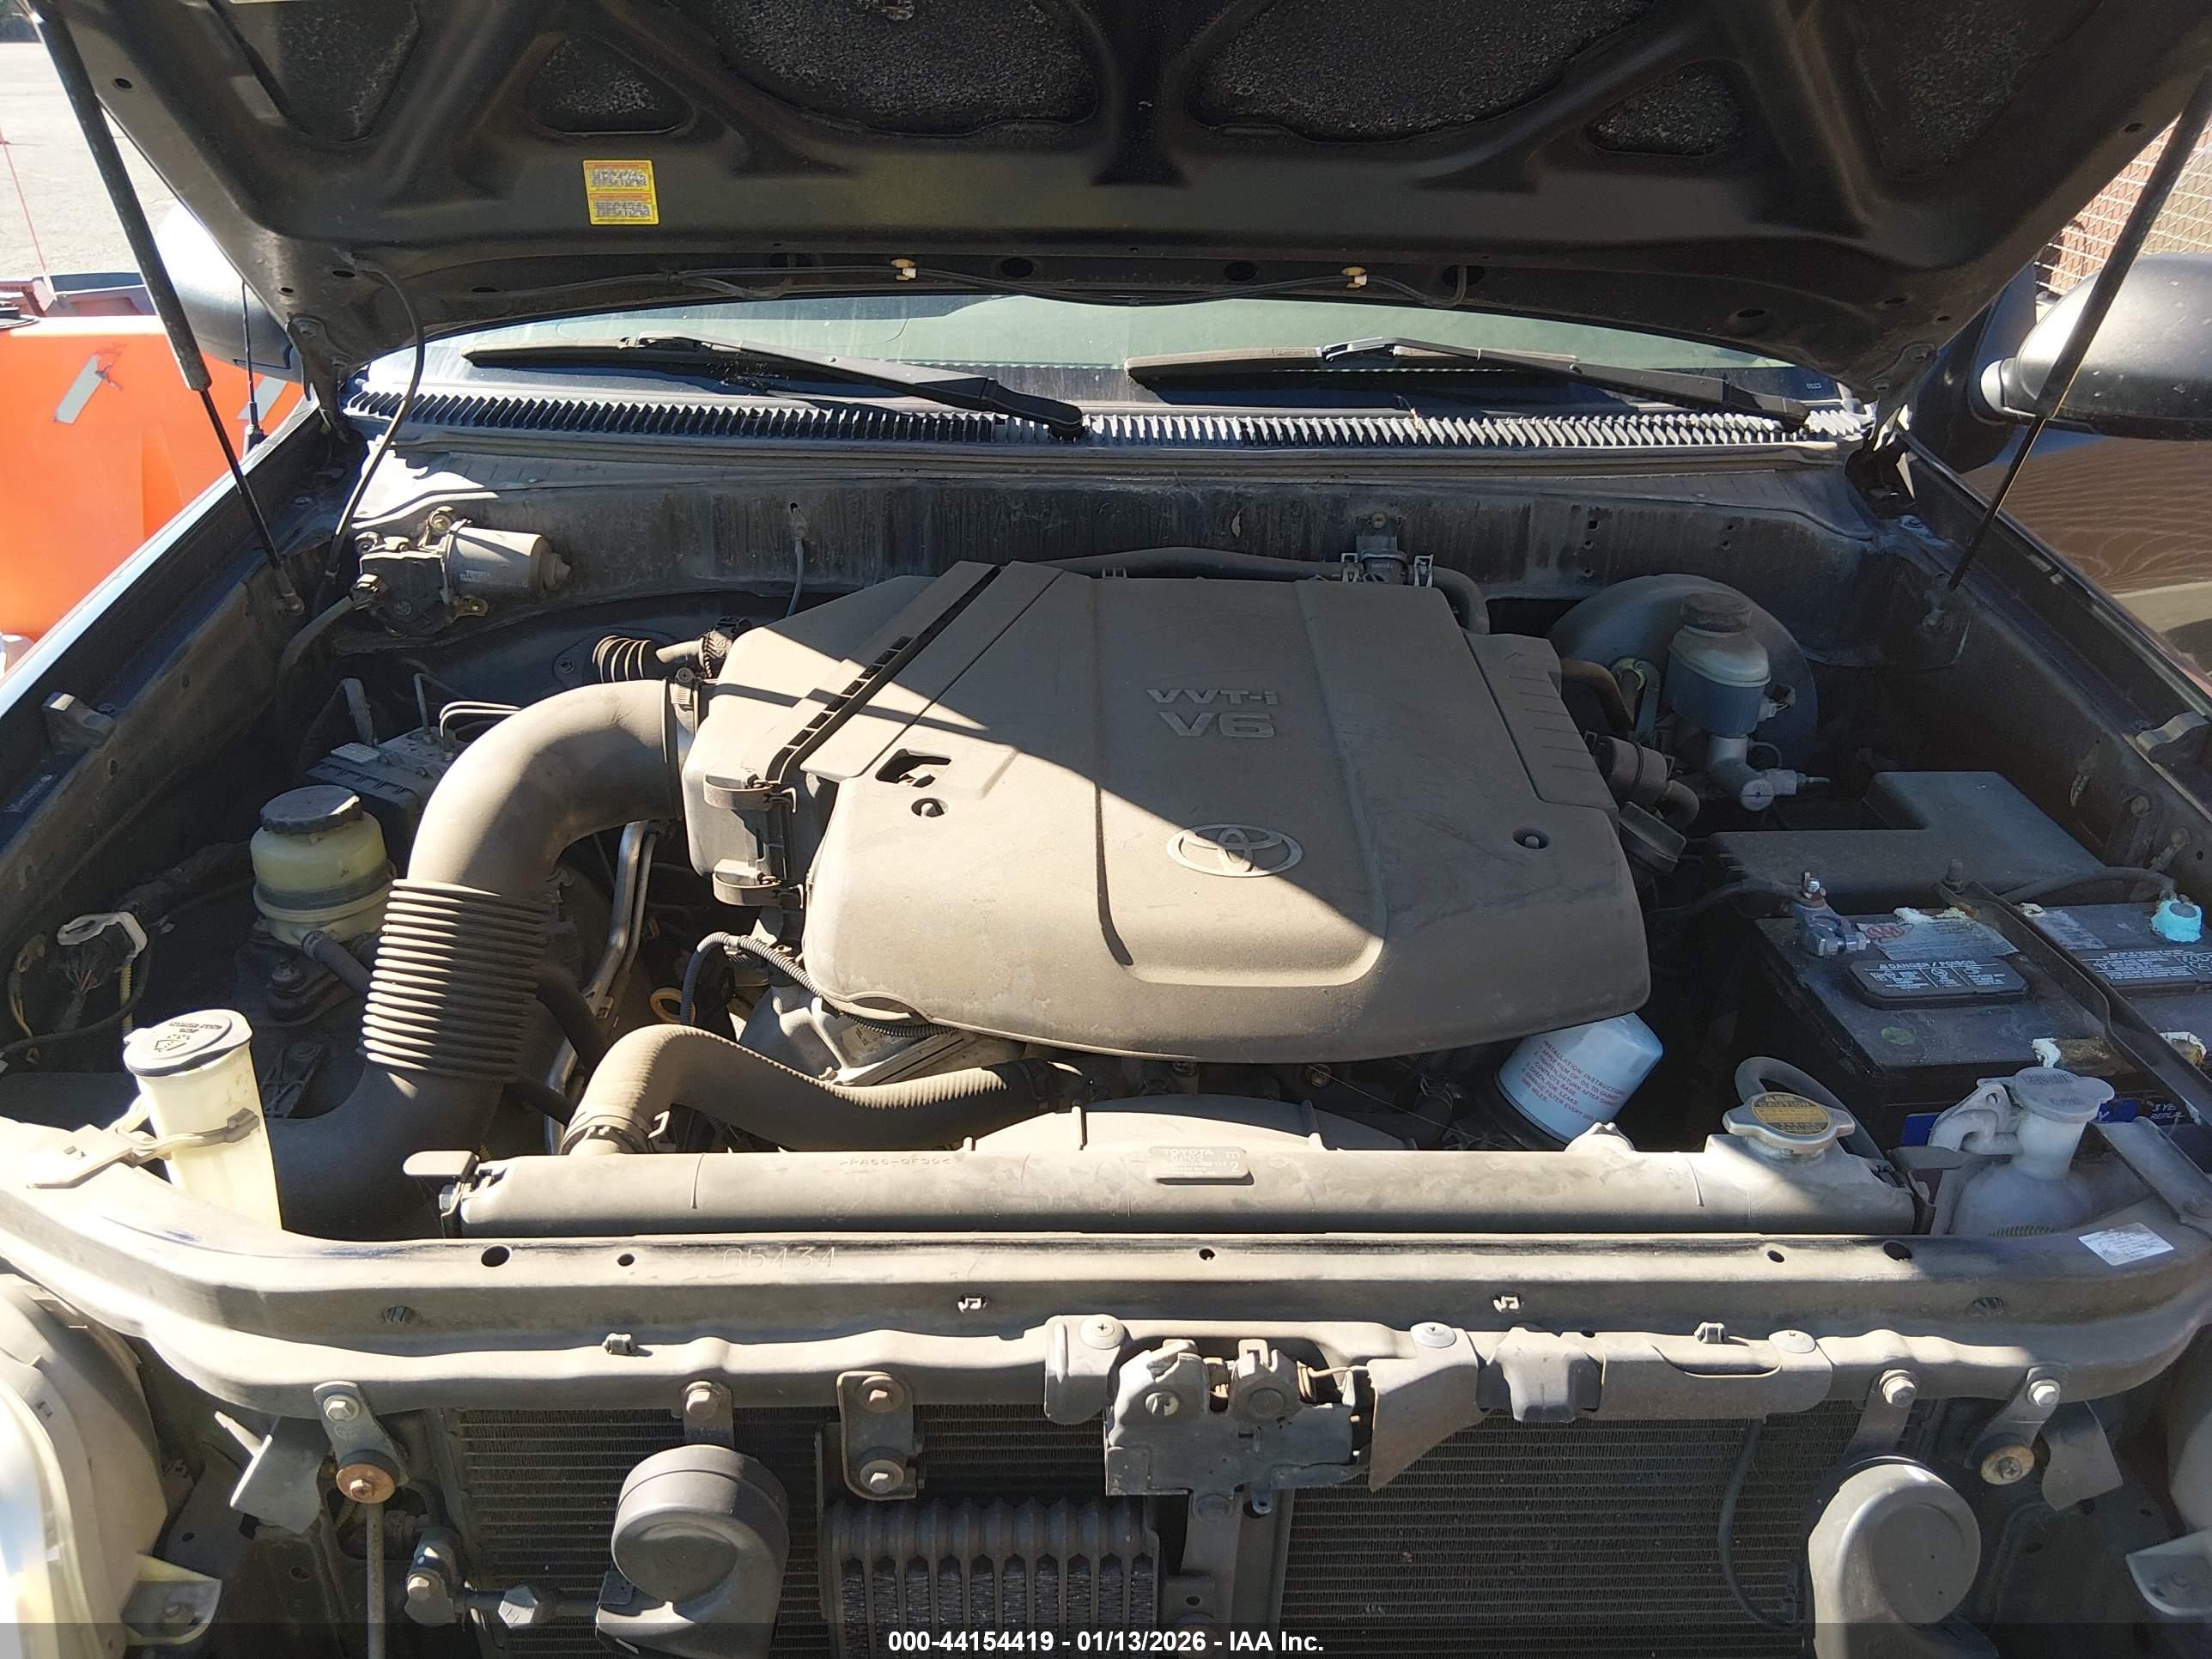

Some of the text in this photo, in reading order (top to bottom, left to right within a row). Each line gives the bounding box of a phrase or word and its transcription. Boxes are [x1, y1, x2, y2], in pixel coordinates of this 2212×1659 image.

[1147, 689, 1278, 705] VVT-i
[1158, 712, 1274, 738] V6
[1939, 959, 1977, 968] POISON
[1559, 1083, 1576, 1096] BASE
[1581, 1088, 1600, 1101] AFTER
[1590, 1085, 1600, 1094] TO
